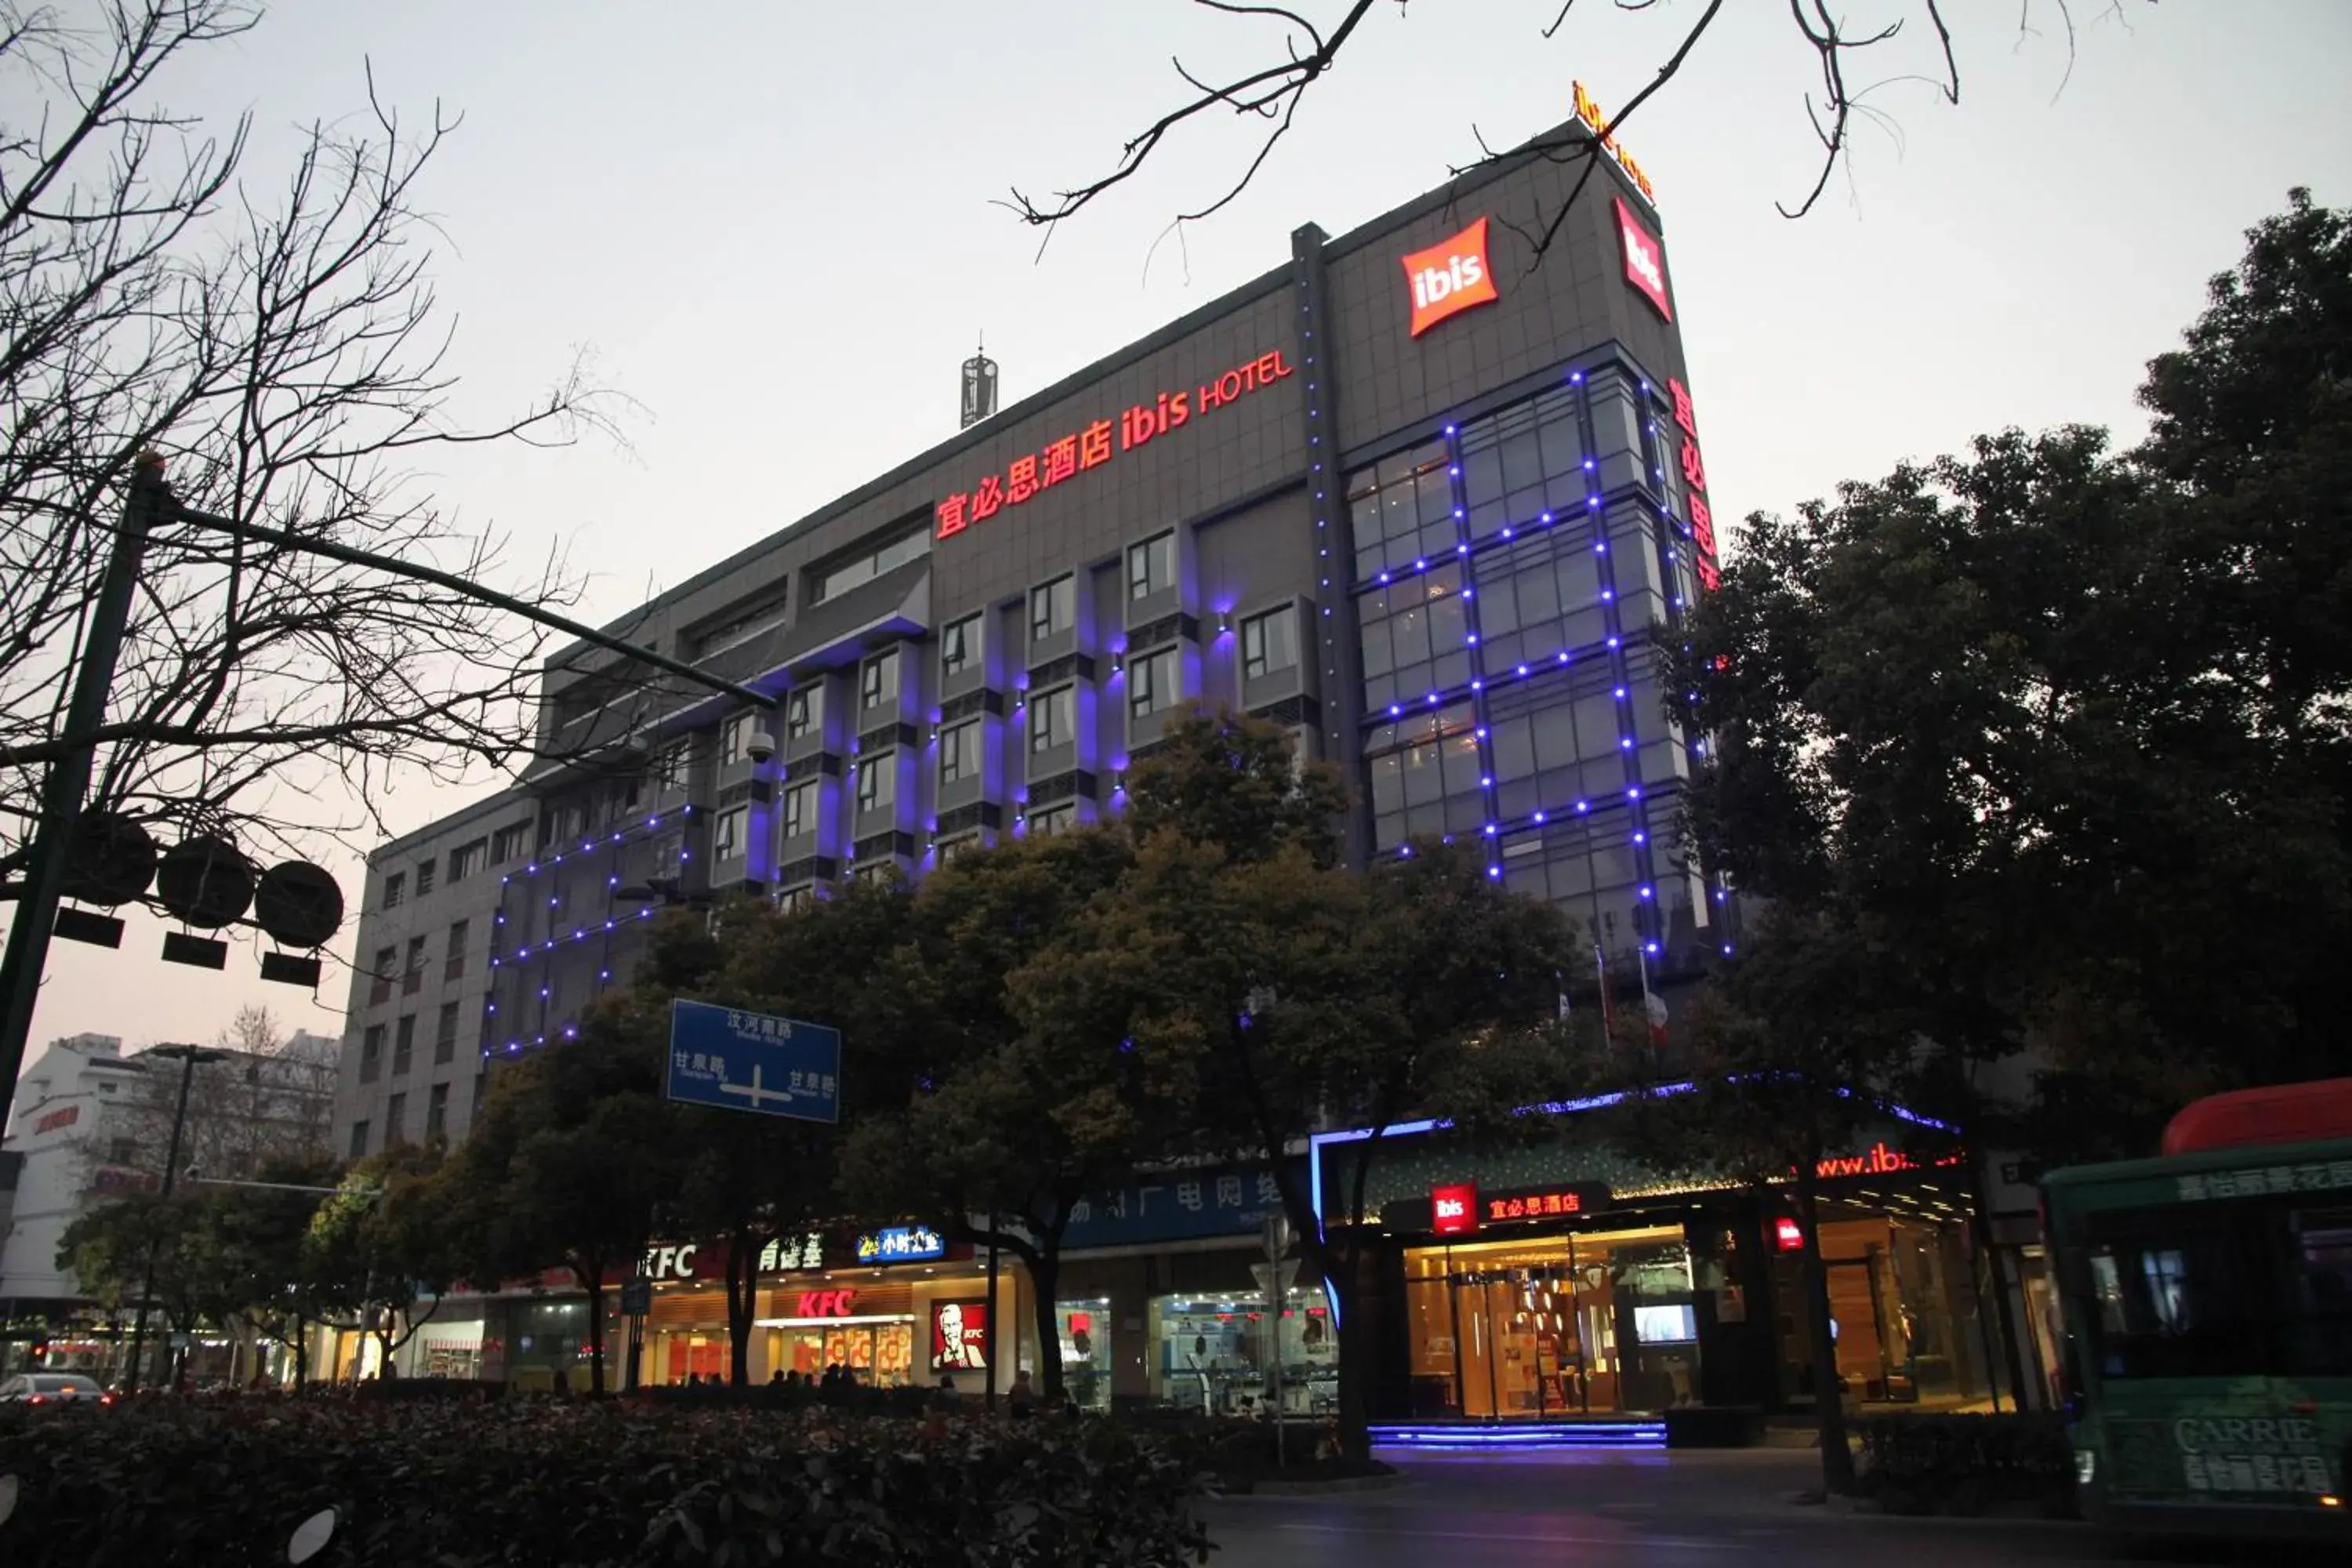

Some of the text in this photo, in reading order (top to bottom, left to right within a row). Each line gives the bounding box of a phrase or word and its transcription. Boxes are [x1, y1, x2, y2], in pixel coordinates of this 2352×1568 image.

[1414, 255, 1483, 309] ibis
[936, 351, 1294, 539] 宜必思酒店 ibis HOTEL
[1436, 1199, 1464, 1218] ibis
[1489, 1192, 1581, 1220] 宜必思酒店
[797, 1288, 857, 1317] KFC
[964, 1328, 984, 1339] KFC
[2174, 1417, 2318, 1454] CARRIE
